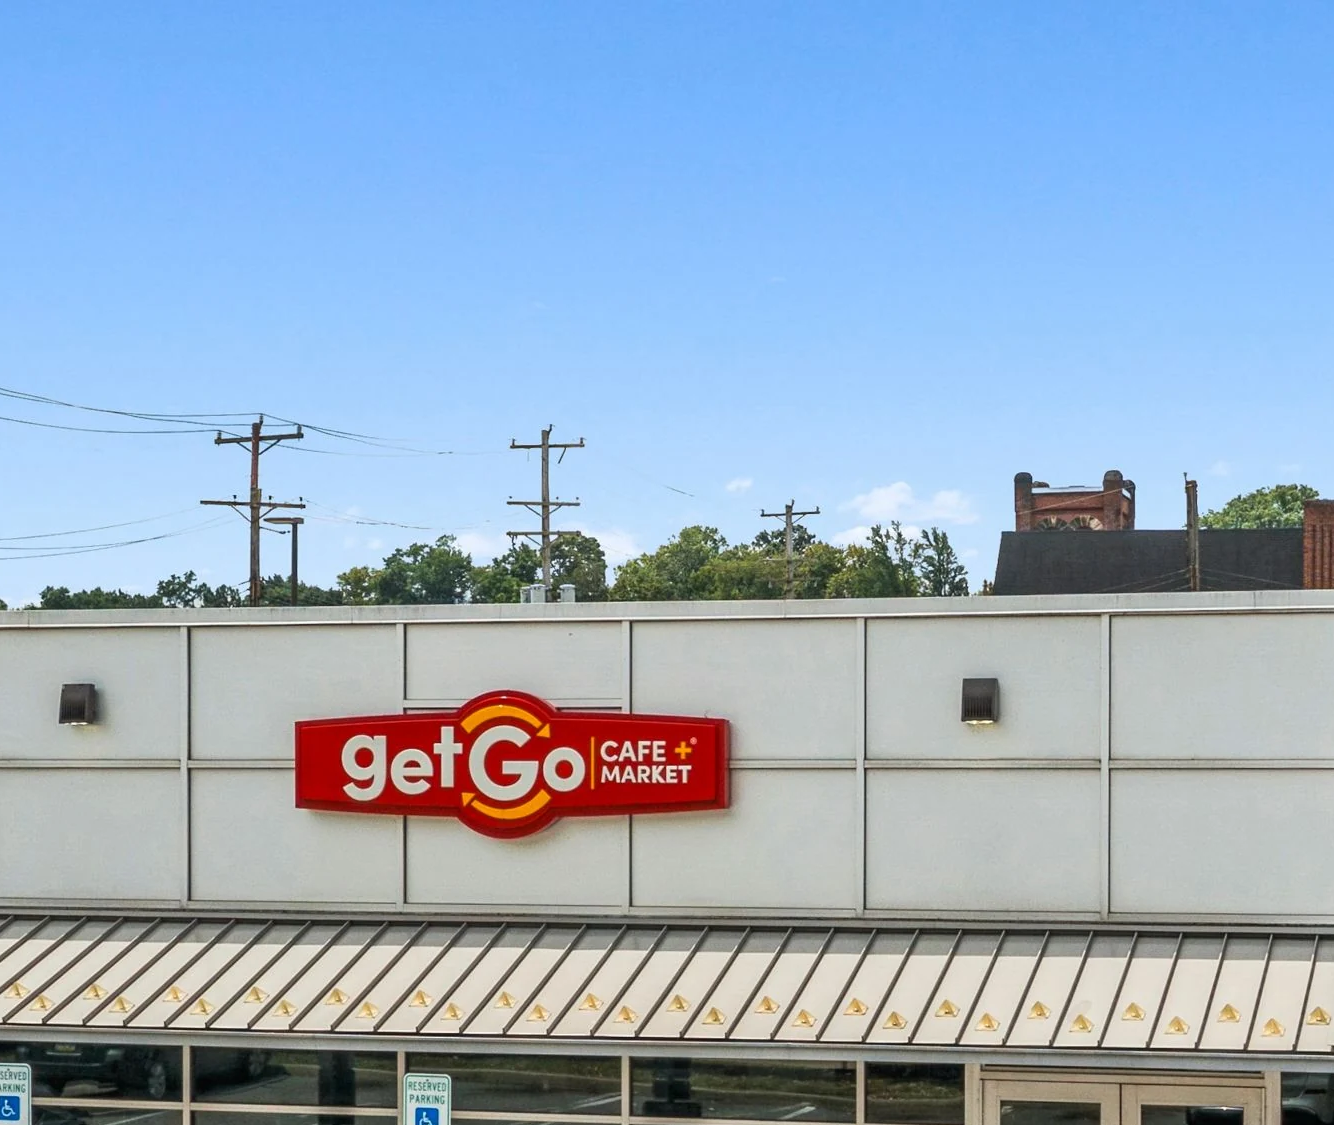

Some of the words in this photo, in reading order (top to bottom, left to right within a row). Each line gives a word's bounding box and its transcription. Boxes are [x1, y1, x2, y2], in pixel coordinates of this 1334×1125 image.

[600, 741, 666, 763] CAFE
[341, 726, 586, 801] getGo
[601, 765, 692, 784] MARKET
[408, 1081, 446, 1091] RESERVED
[409, 1094, 445, 1104] PARKING
